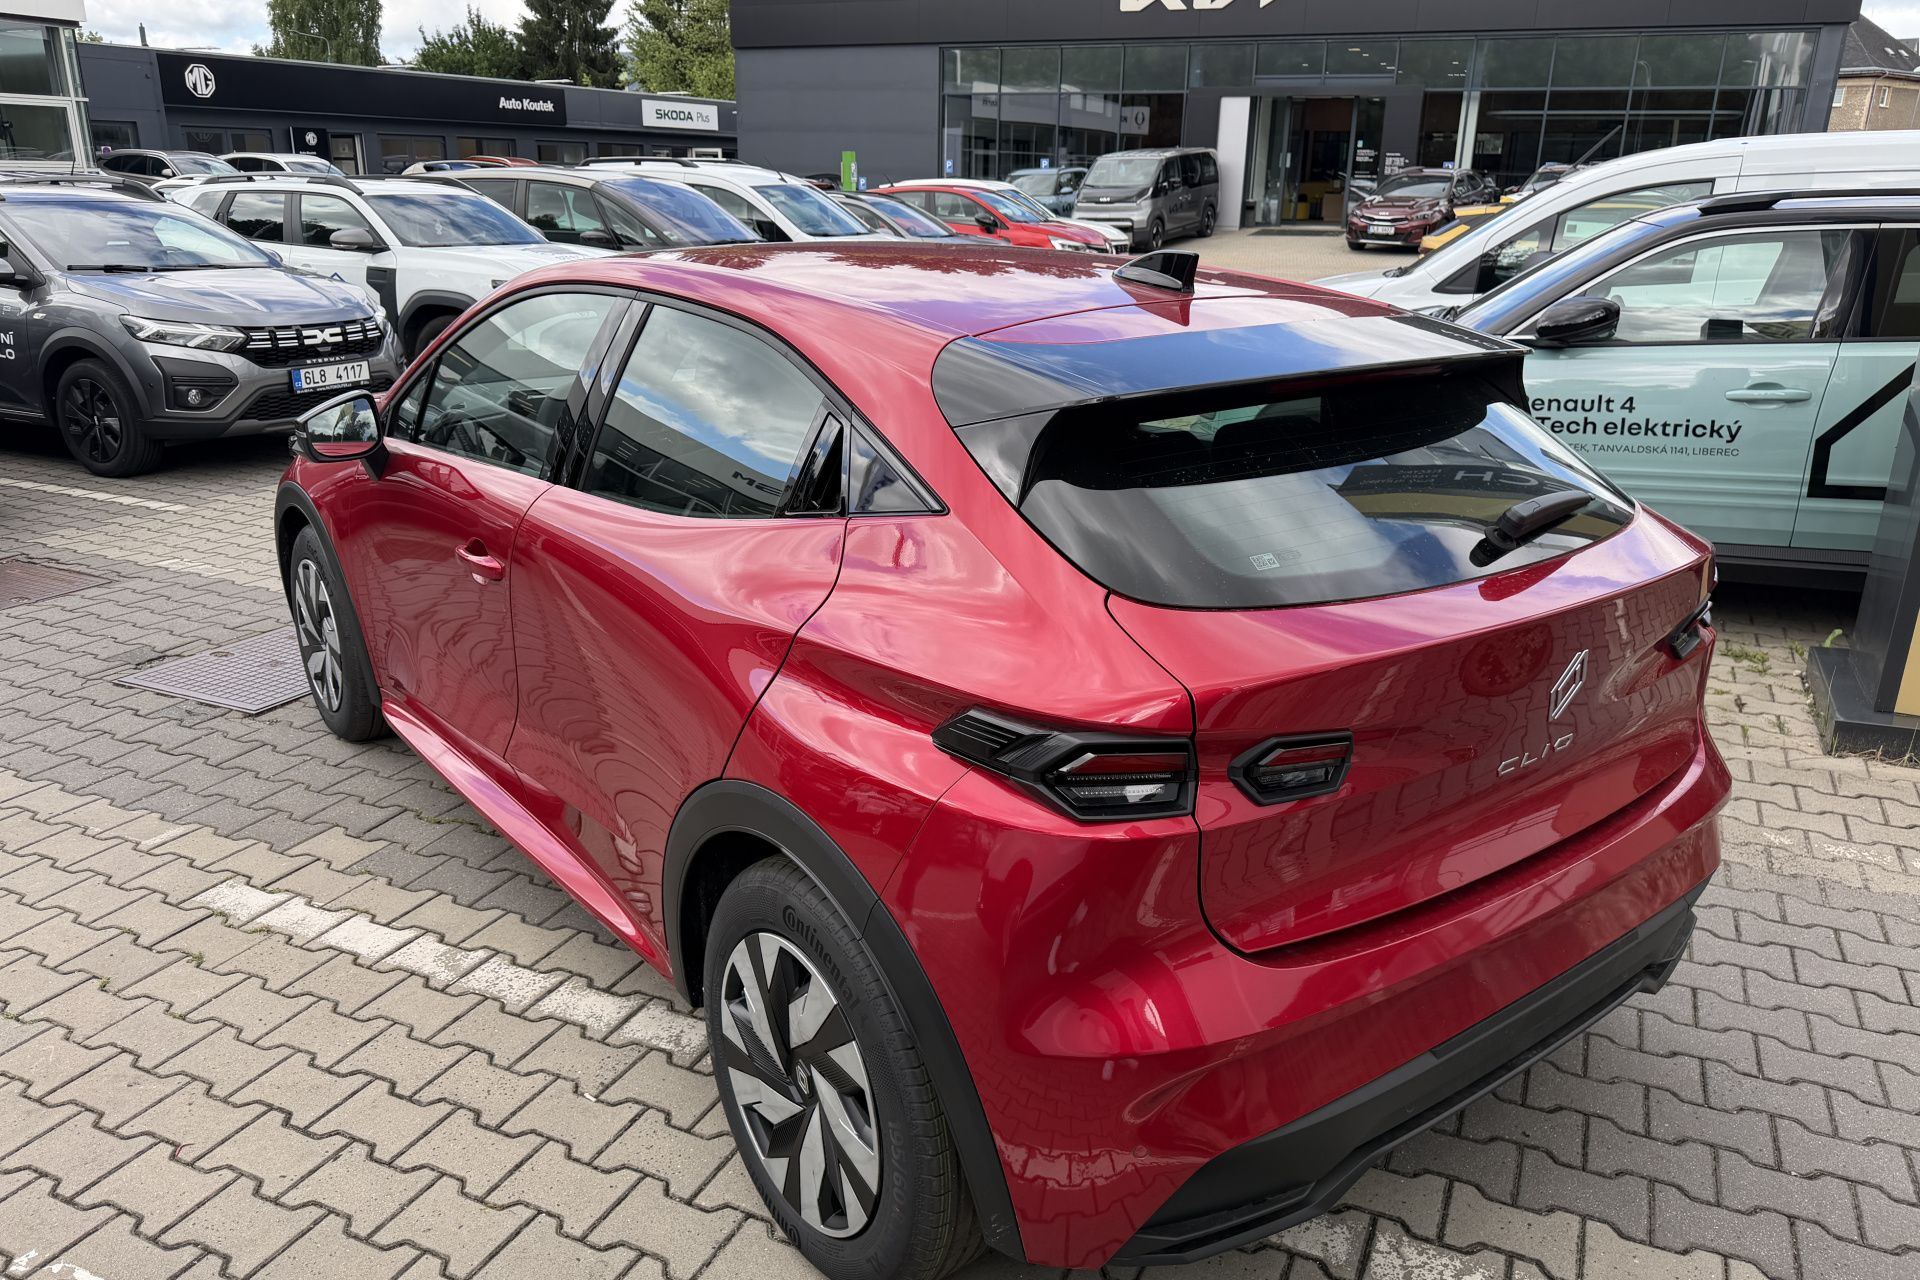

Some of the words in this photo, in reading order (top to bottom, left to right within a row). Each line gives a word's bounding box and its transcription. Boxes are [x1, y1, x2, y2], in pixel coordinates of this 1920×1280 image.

[187, 66, 214, 96] MG
[499, 96, 522, 110] Auto
[523, 98, 554, 113] Koutek
[696, 111, 710, 123] Plus
[304, 369, 327, 386] 6L8
[336, 364, 363, 381] 4117
[1530, 394, 1614, 413] enault
[1620, 396, 1636, 413] 4
[1603, 417, 1743, 443] elektrický
[1592, 443, 1668, 455] TANVALDSKÁ
[1670, 446, 1690, 457] 1141,
[1692, 447, 1740, 457] LIBEREC
[1497, 732, 1574, 778] CLIO
[782, 904, 861, 1010] Continental
